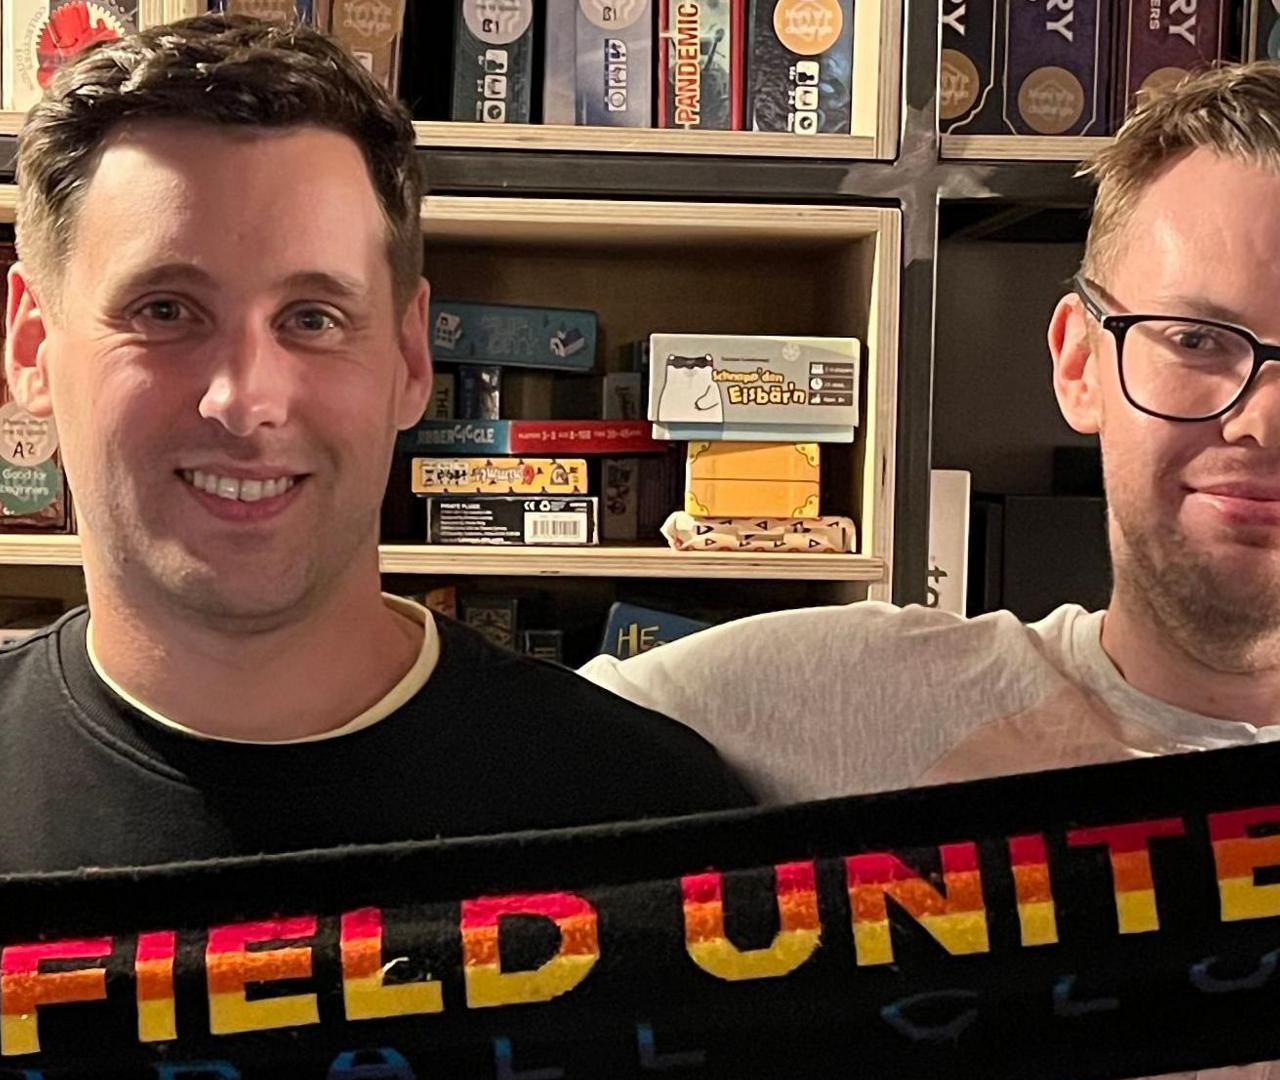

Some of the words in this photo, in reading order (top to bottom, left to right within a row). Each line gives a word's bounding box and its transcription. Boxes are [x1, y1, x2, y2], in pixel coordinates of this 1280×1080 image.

[676, 3, 699, 125] PANDEMIC
[727, 381, 807, 405] Eisbär'n
[2, 468, 30, 480] Good
[32, 467, 47, 480] for
[0, 483, 50, 498] beginners
